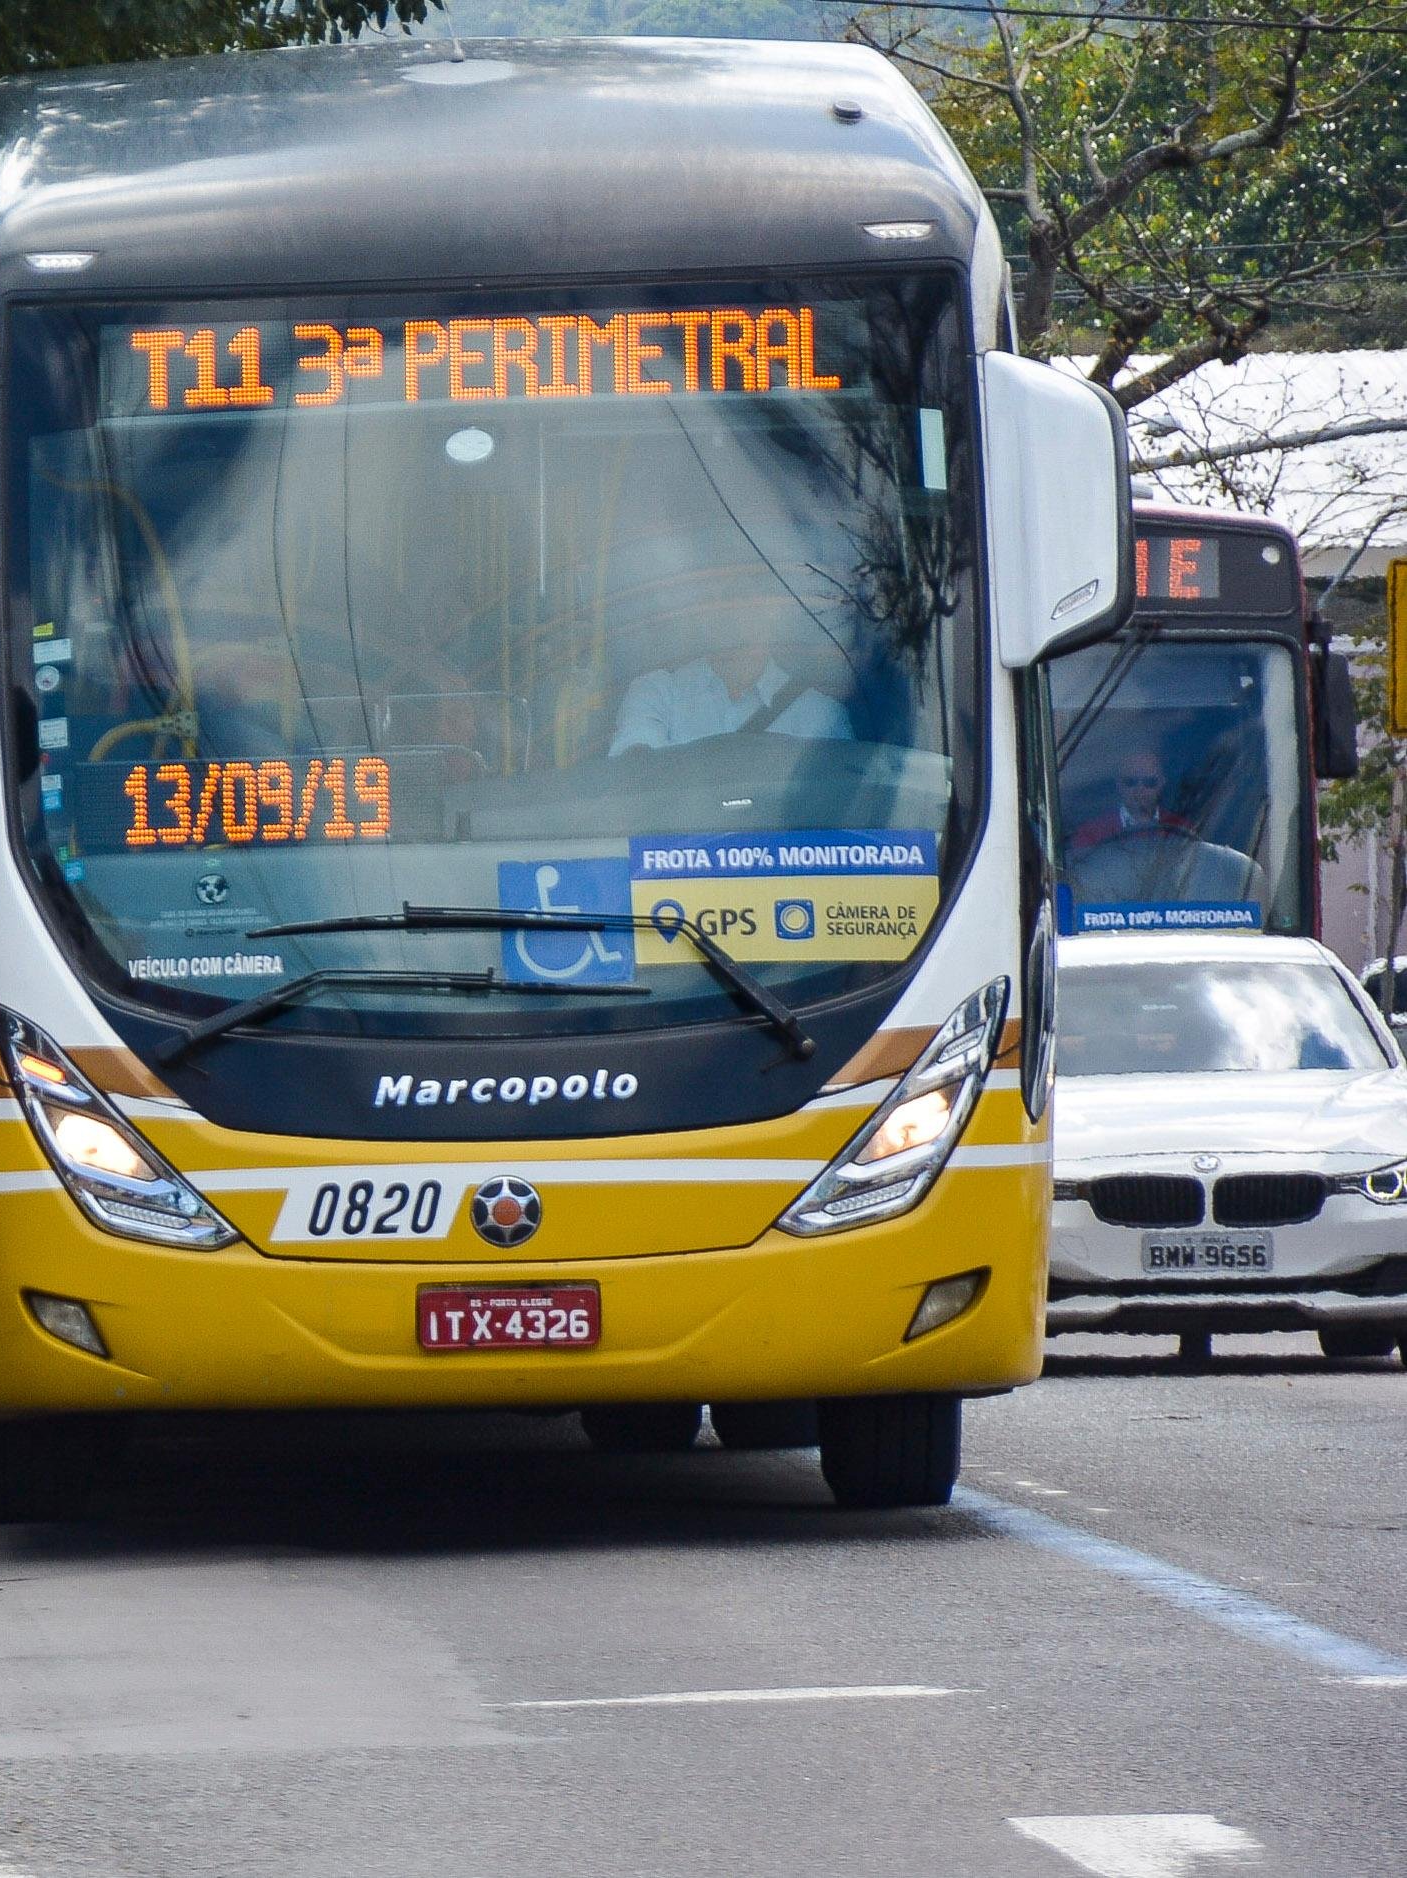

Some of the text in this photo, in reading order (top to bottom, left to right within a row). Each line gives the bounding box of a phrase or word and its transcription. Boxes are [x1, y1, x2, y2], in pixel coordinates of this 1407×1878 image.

[131, 327, 274, 409] T11
[403, 307, 842, 401] PERIMETRAL
[124, 757, 390, 845] 13/09/19
[643, 845, 925, 871] FROTA 100% MONITORADA
[696, 908, 757, 936] GPS
[826, 903, 916, 920] CÂMERA DE
[826, 921, 917, 939] SEGURANÇA
[128, 952, 284, 978] VEÍCULO COM CÂMERA
[374, 1069, 639, 1107] Marcopolo
[308, 1179, 442, 1236] 0820
